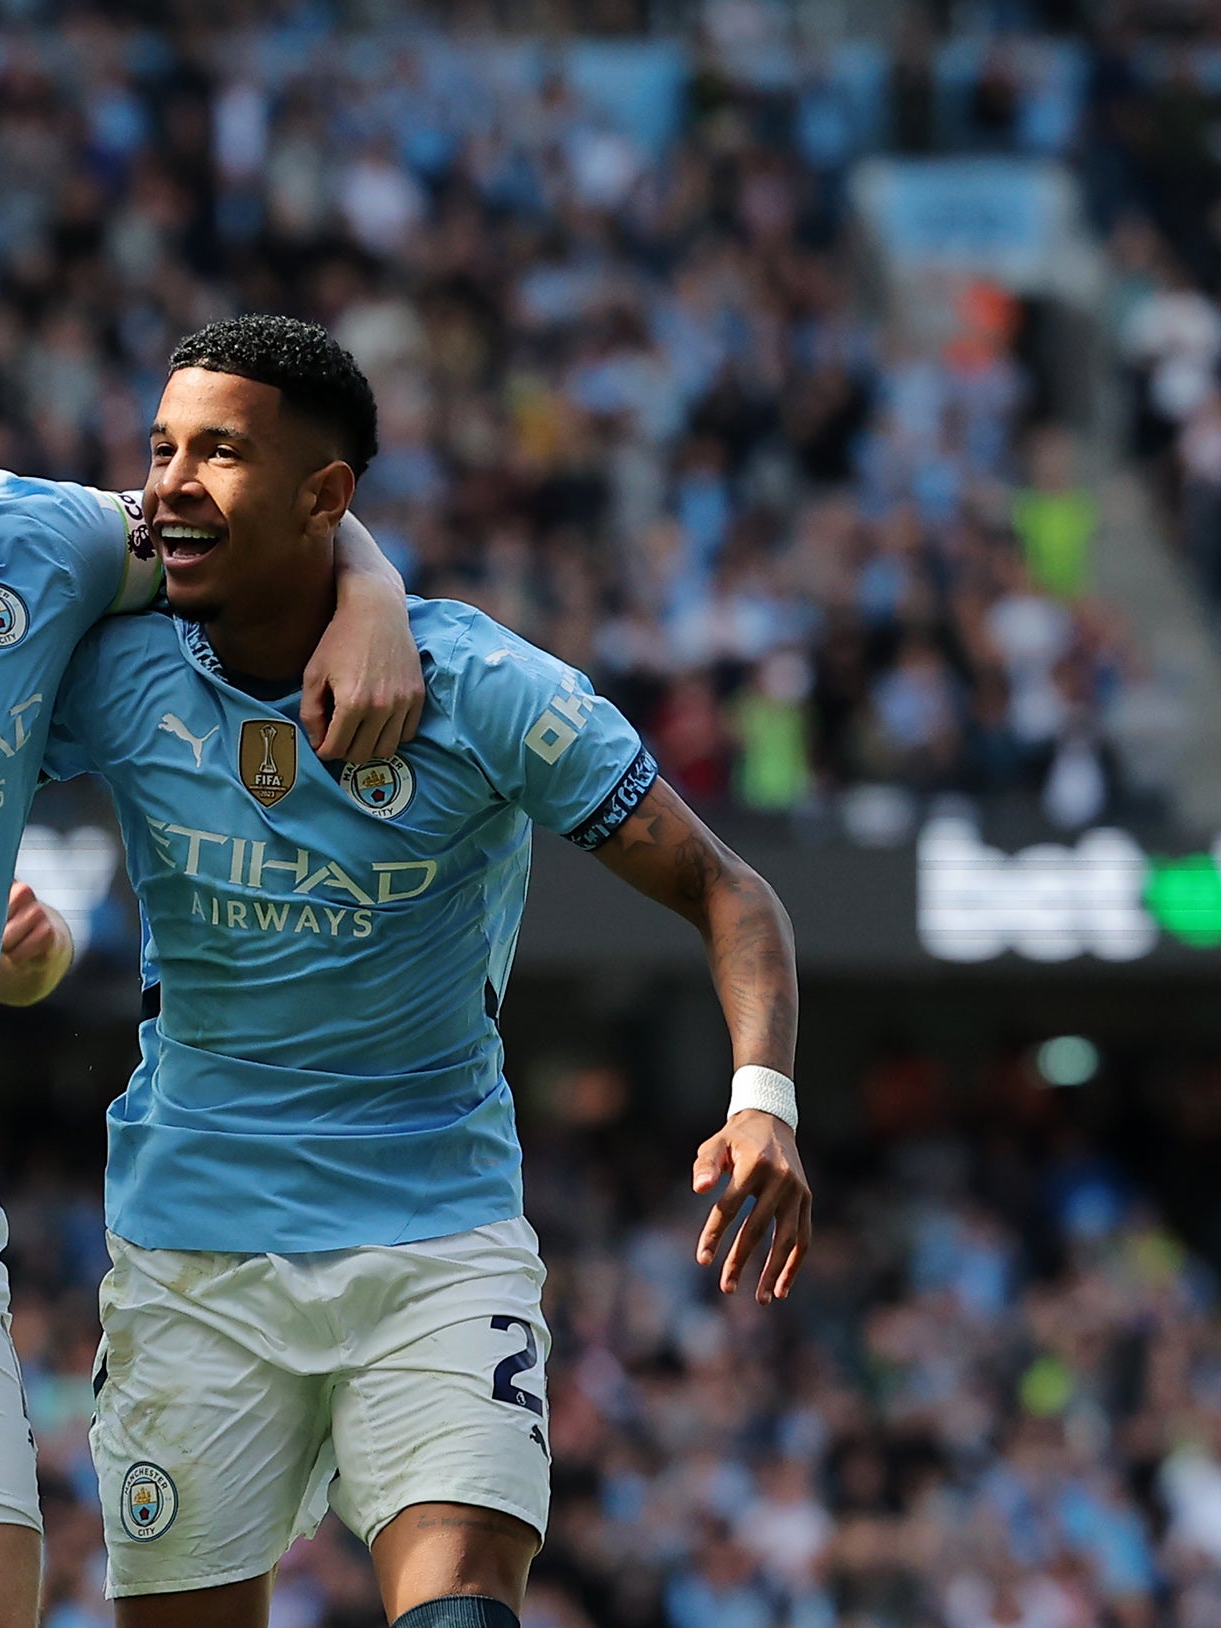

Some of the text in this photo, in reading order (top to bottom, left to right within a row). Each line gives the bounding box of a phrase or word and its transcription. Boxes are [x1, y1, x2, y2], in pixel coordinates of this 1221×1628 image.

[255, 774, 282, 786] FIFA
[191, 891, 373, 938] AIRWAYS
[124, 1468, 168, 1496] MANCHESTER
[137, 1527, 156, 1537] CITY
